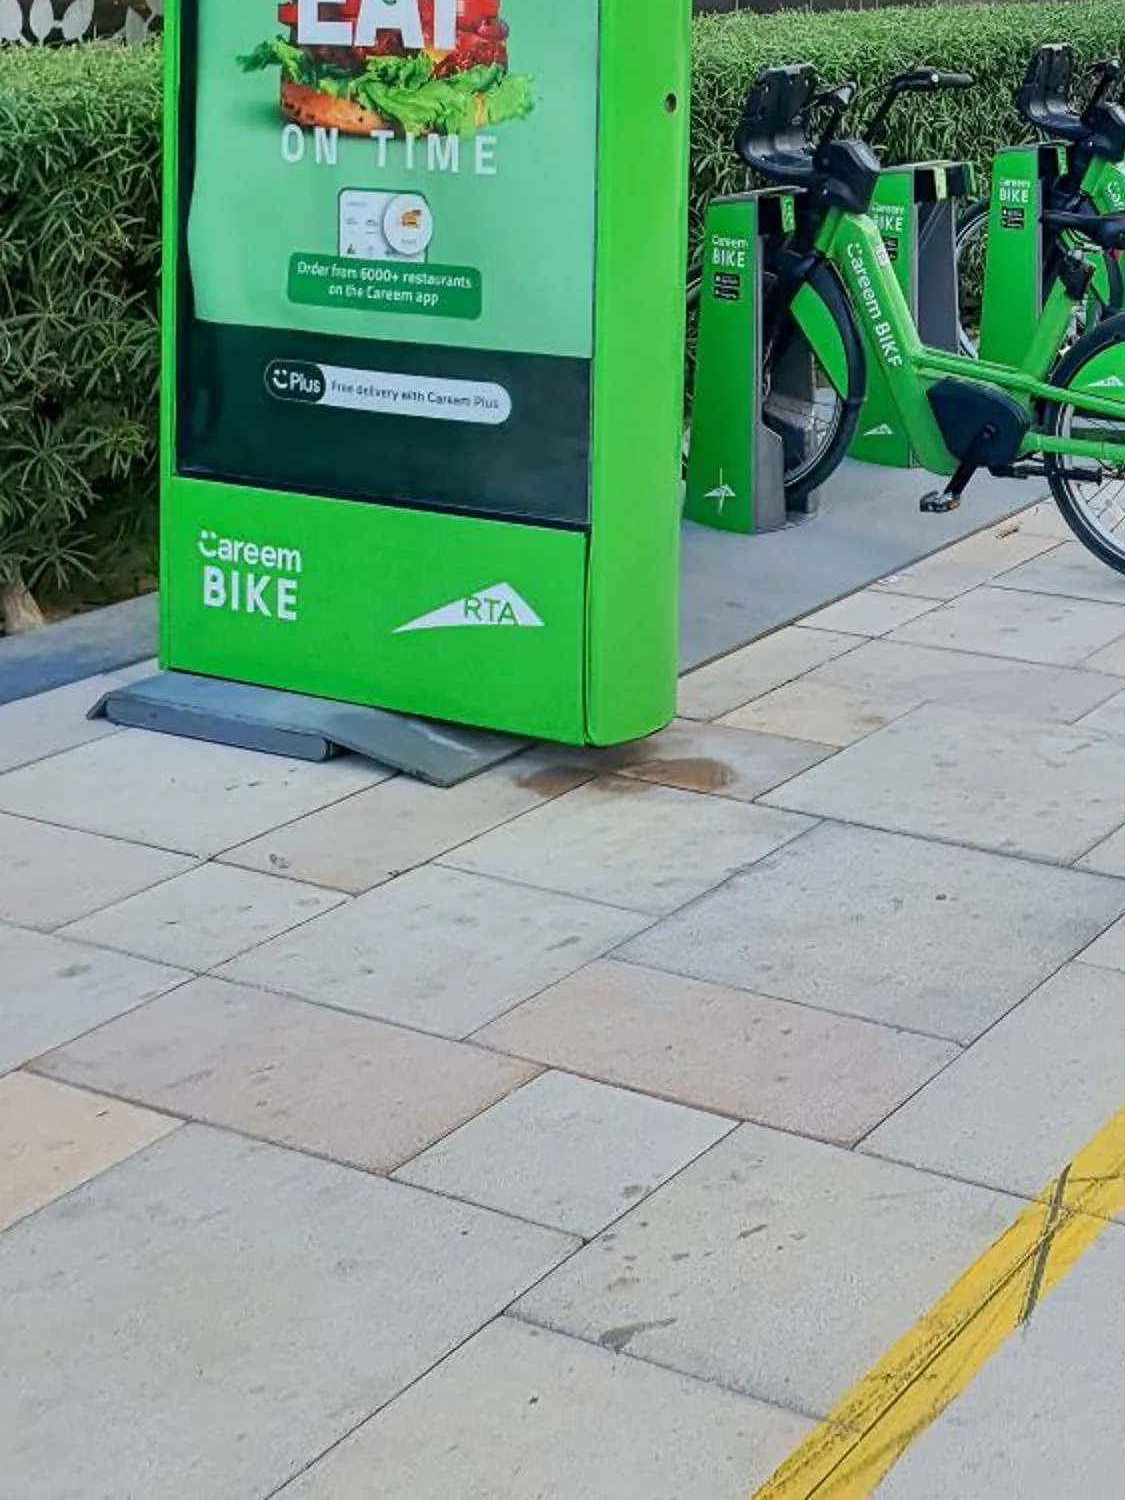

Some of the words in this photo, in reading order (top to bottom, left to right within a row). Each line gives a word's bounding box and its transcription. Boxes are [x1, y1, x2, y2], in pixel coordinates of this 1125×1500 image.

[281, 123, 339, 165] ON
[371, 129, 498, 175] TIME
[999, 187, 1029, 203] BIKE
[712, 248, 746, 268] BIKE
[297, 261, 328, 276] Order
[331, 263, 357, 279] from
[359, 268, 398, 282] 6000+
[402, 273, 472, 289] restaurants
[328, 285, 343, 296] on
[345, 284, 363, 298] the
[367, 287, 413, 303] Careem
[415, 291, 439, 307] app
[847, 242, 882, 320] Careem
[874, 321, 904, 368] BIKE
[289, 373, 321, 394] Plus
[198, 529, 302, 573] Careem
[203, 565, 298, 621] BIKE
[463, 597, 520, 627] RTA
